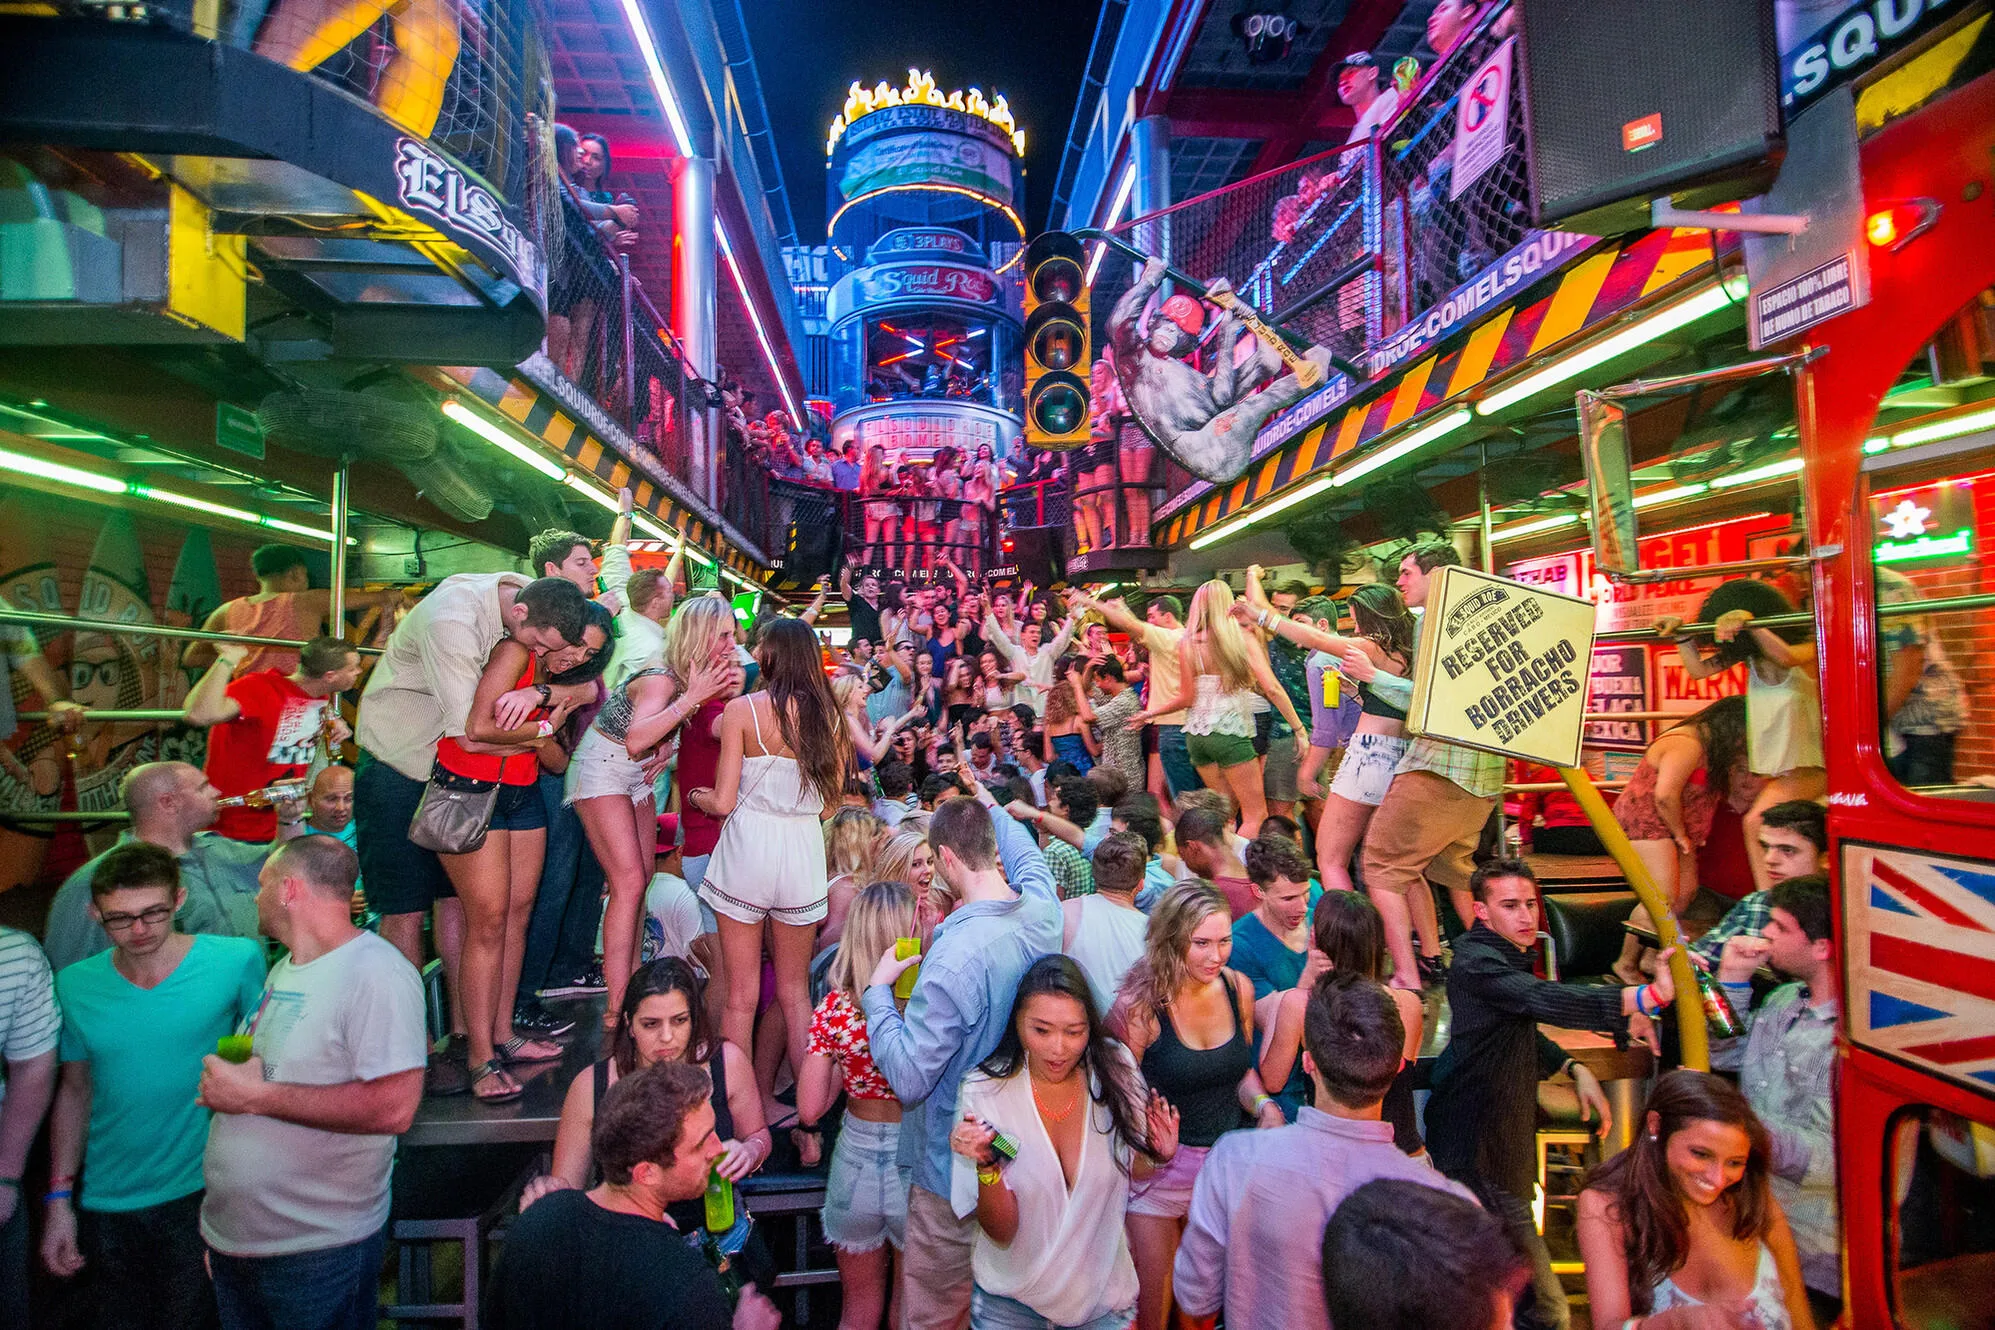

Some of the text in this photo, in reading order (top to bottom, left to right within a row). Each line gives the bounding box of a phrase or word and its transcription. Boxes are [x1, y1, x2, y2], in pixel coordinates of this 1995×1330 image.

[880, 268, 939, 294] Squid
[1460, 597, 1481, 618] SQUID
[1481, 590, 1498, 604] ROE
[1440, 596, 1544, 681] RESERVED
[1484, 640, 1531, 682] FOR
[1464, 638, 1577, 731] BORRACHO
[1491, 669, 1581, 745] DRIVERS
